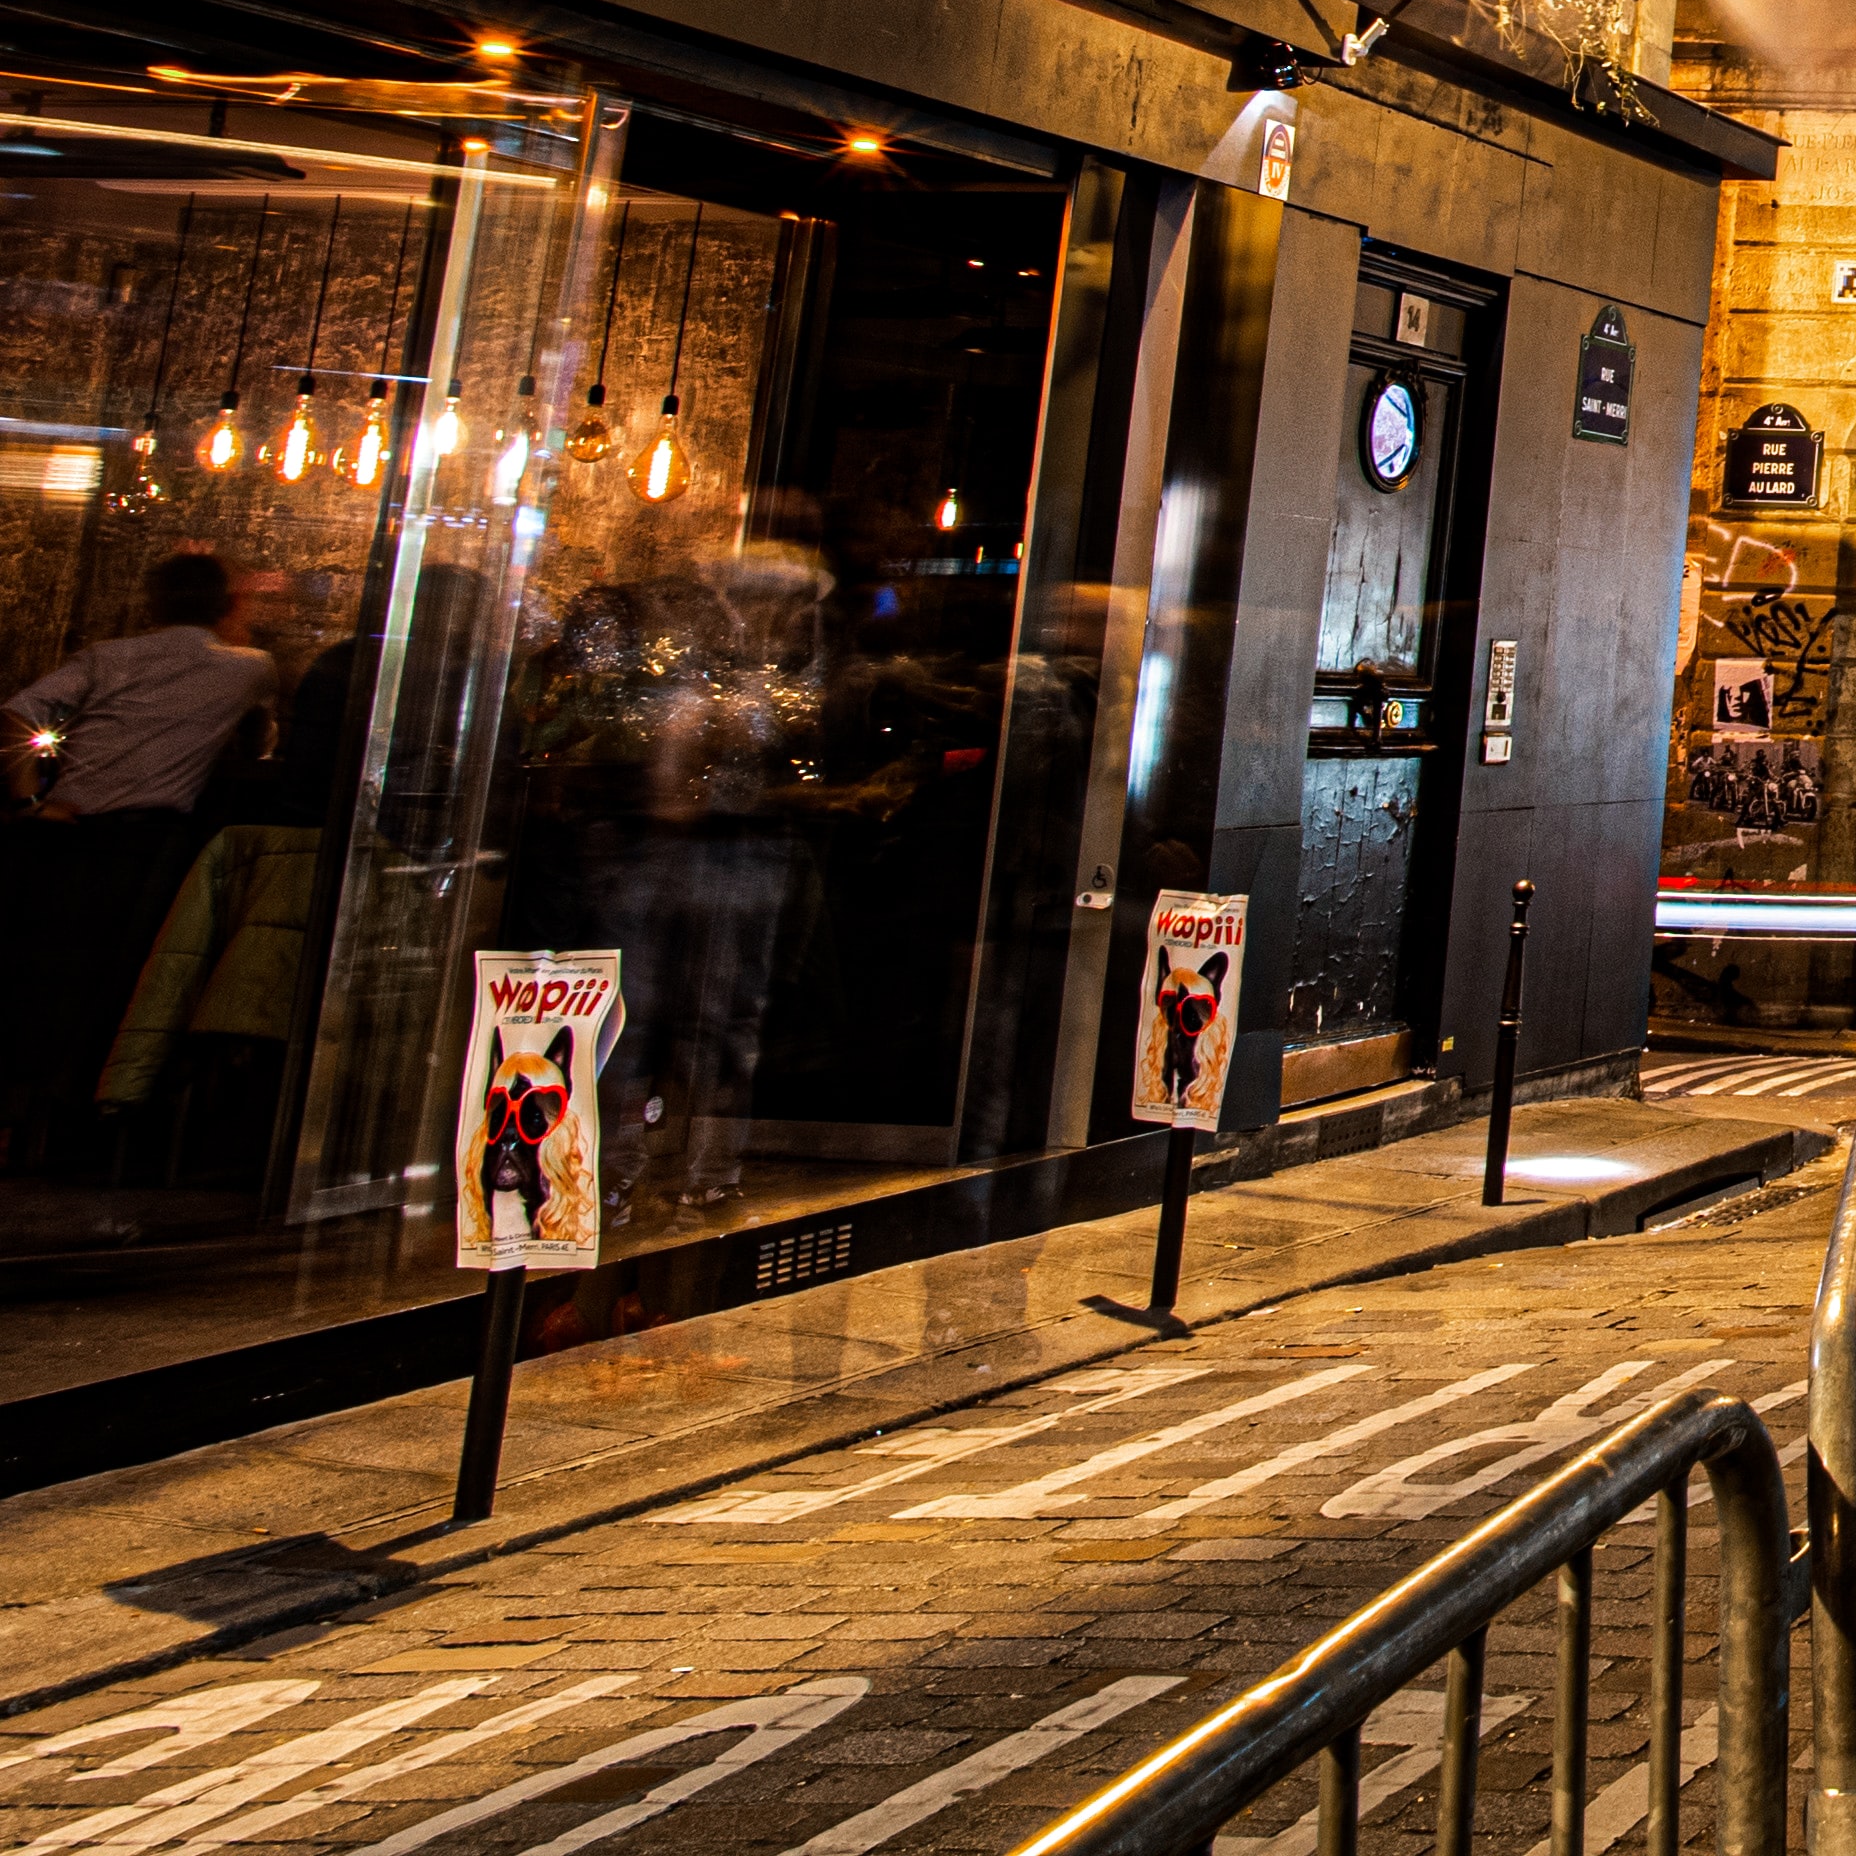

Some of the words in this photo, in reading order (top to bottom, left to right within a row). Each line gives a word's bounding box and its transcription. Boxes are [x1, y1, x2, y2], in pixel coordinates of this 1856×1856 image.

[1407, 305, 1421, 332] 14
[1601, 367, 1615, 384] RUE
[1762, 443, 1787, 456] RUE
[1752, 462, 1795, 476] PIERRE
[1748, 481, 1765, 494] AU
[1766, 481, 1795, 495] LARD
[1157, 907, 1244, 949] Woopiii
